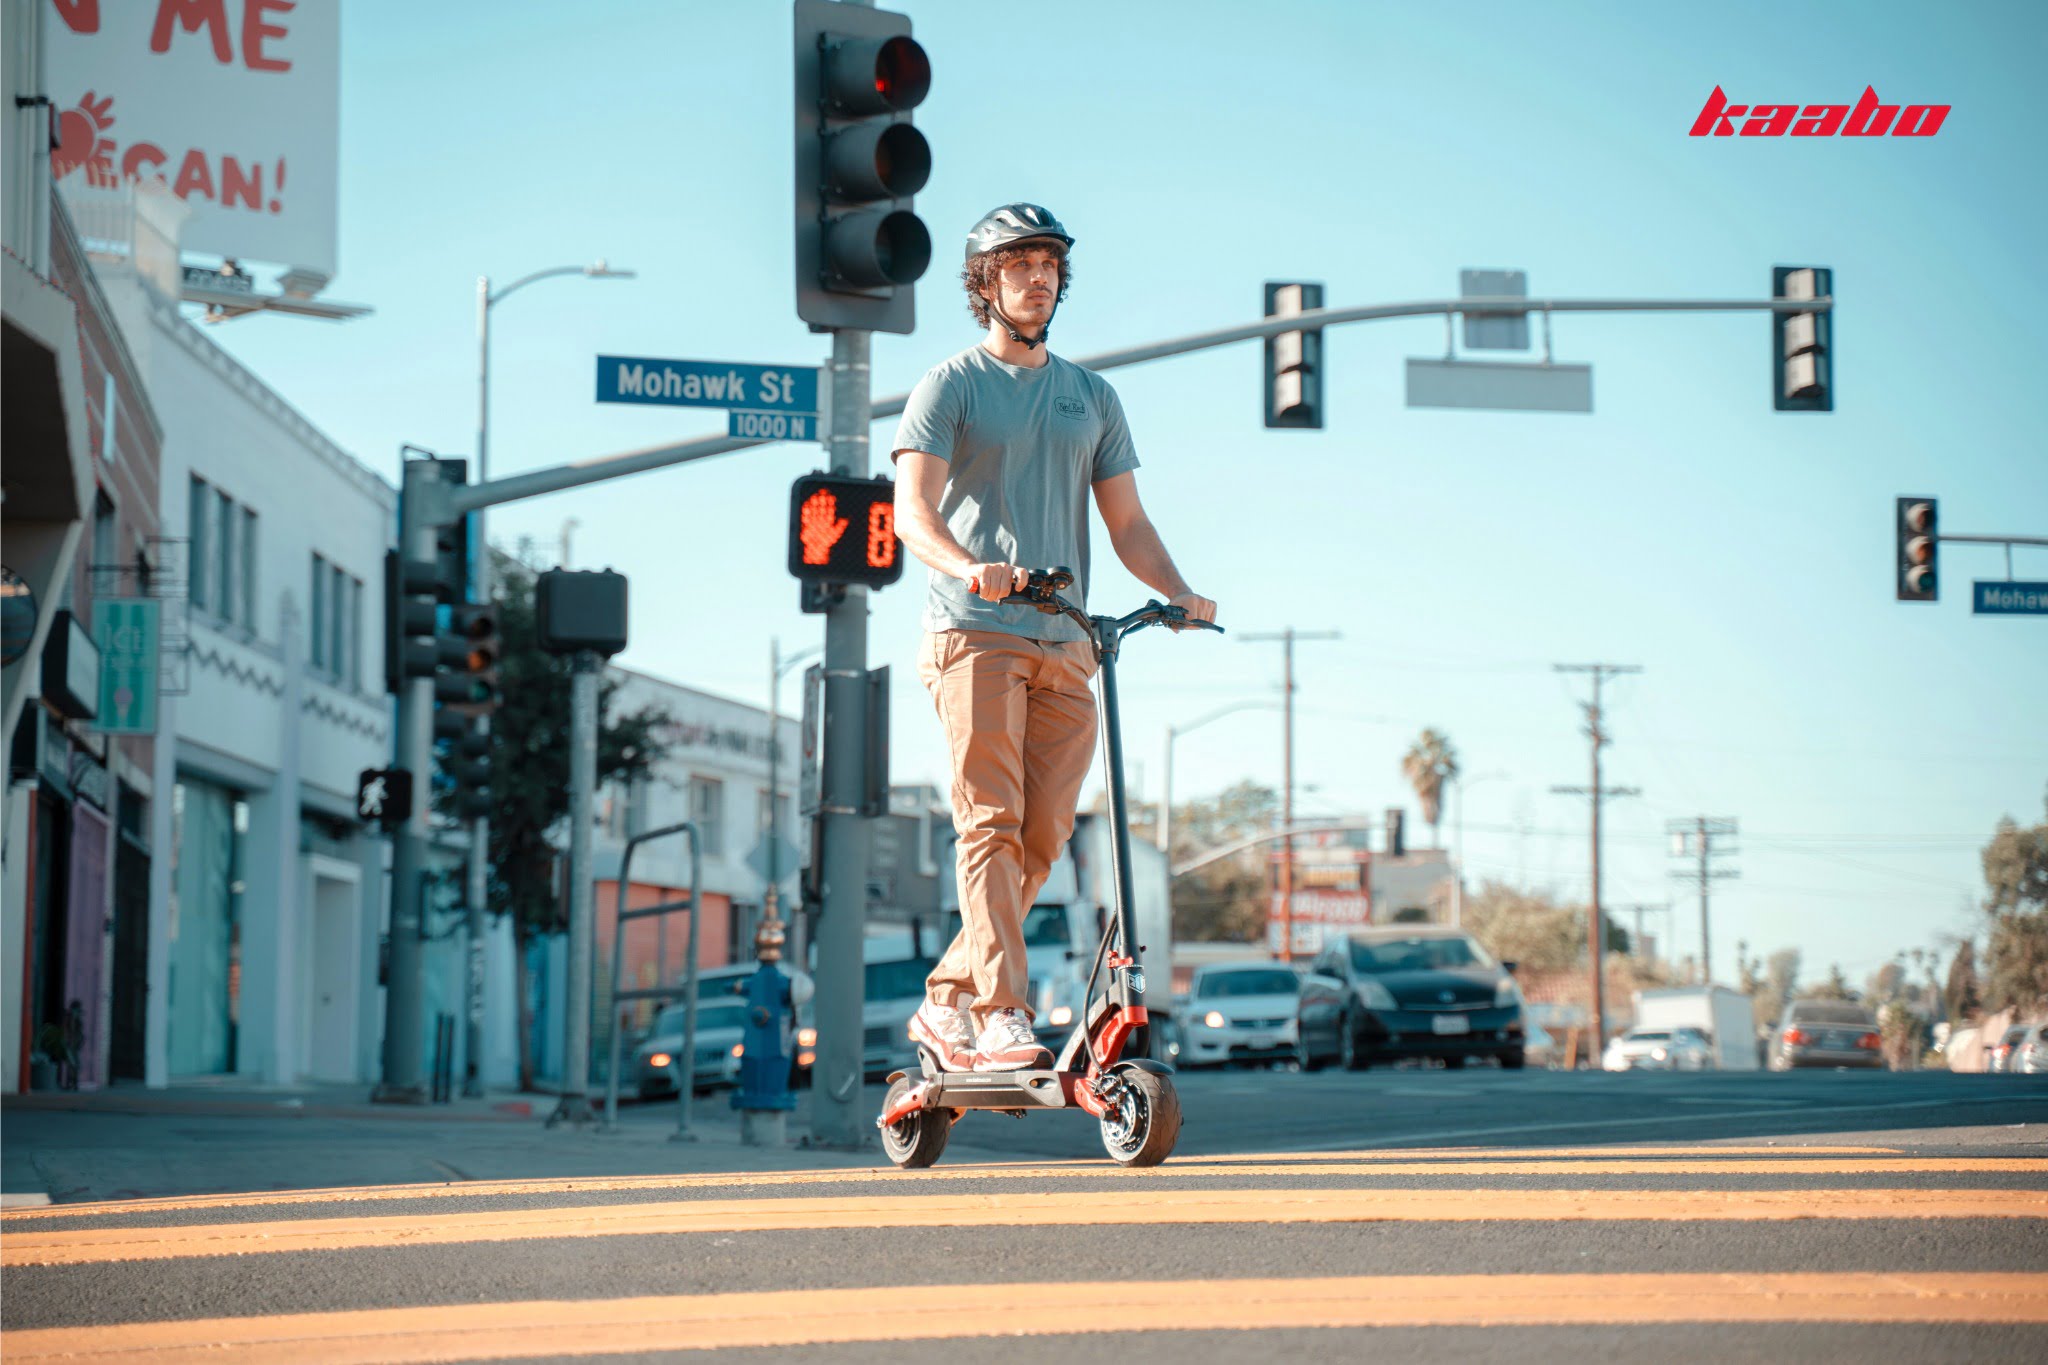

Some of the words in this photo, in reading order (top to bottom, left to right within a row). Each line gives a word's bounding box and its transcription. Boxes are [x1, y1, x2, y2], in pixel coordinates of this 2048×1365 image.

[617, 363, 746, 402] Mohawk
[758, 370, 796, 404] St
[736, 414, 786, 438] 1000
[791, 417, 806, 439] N
[867, 501, 896, 568] 8
